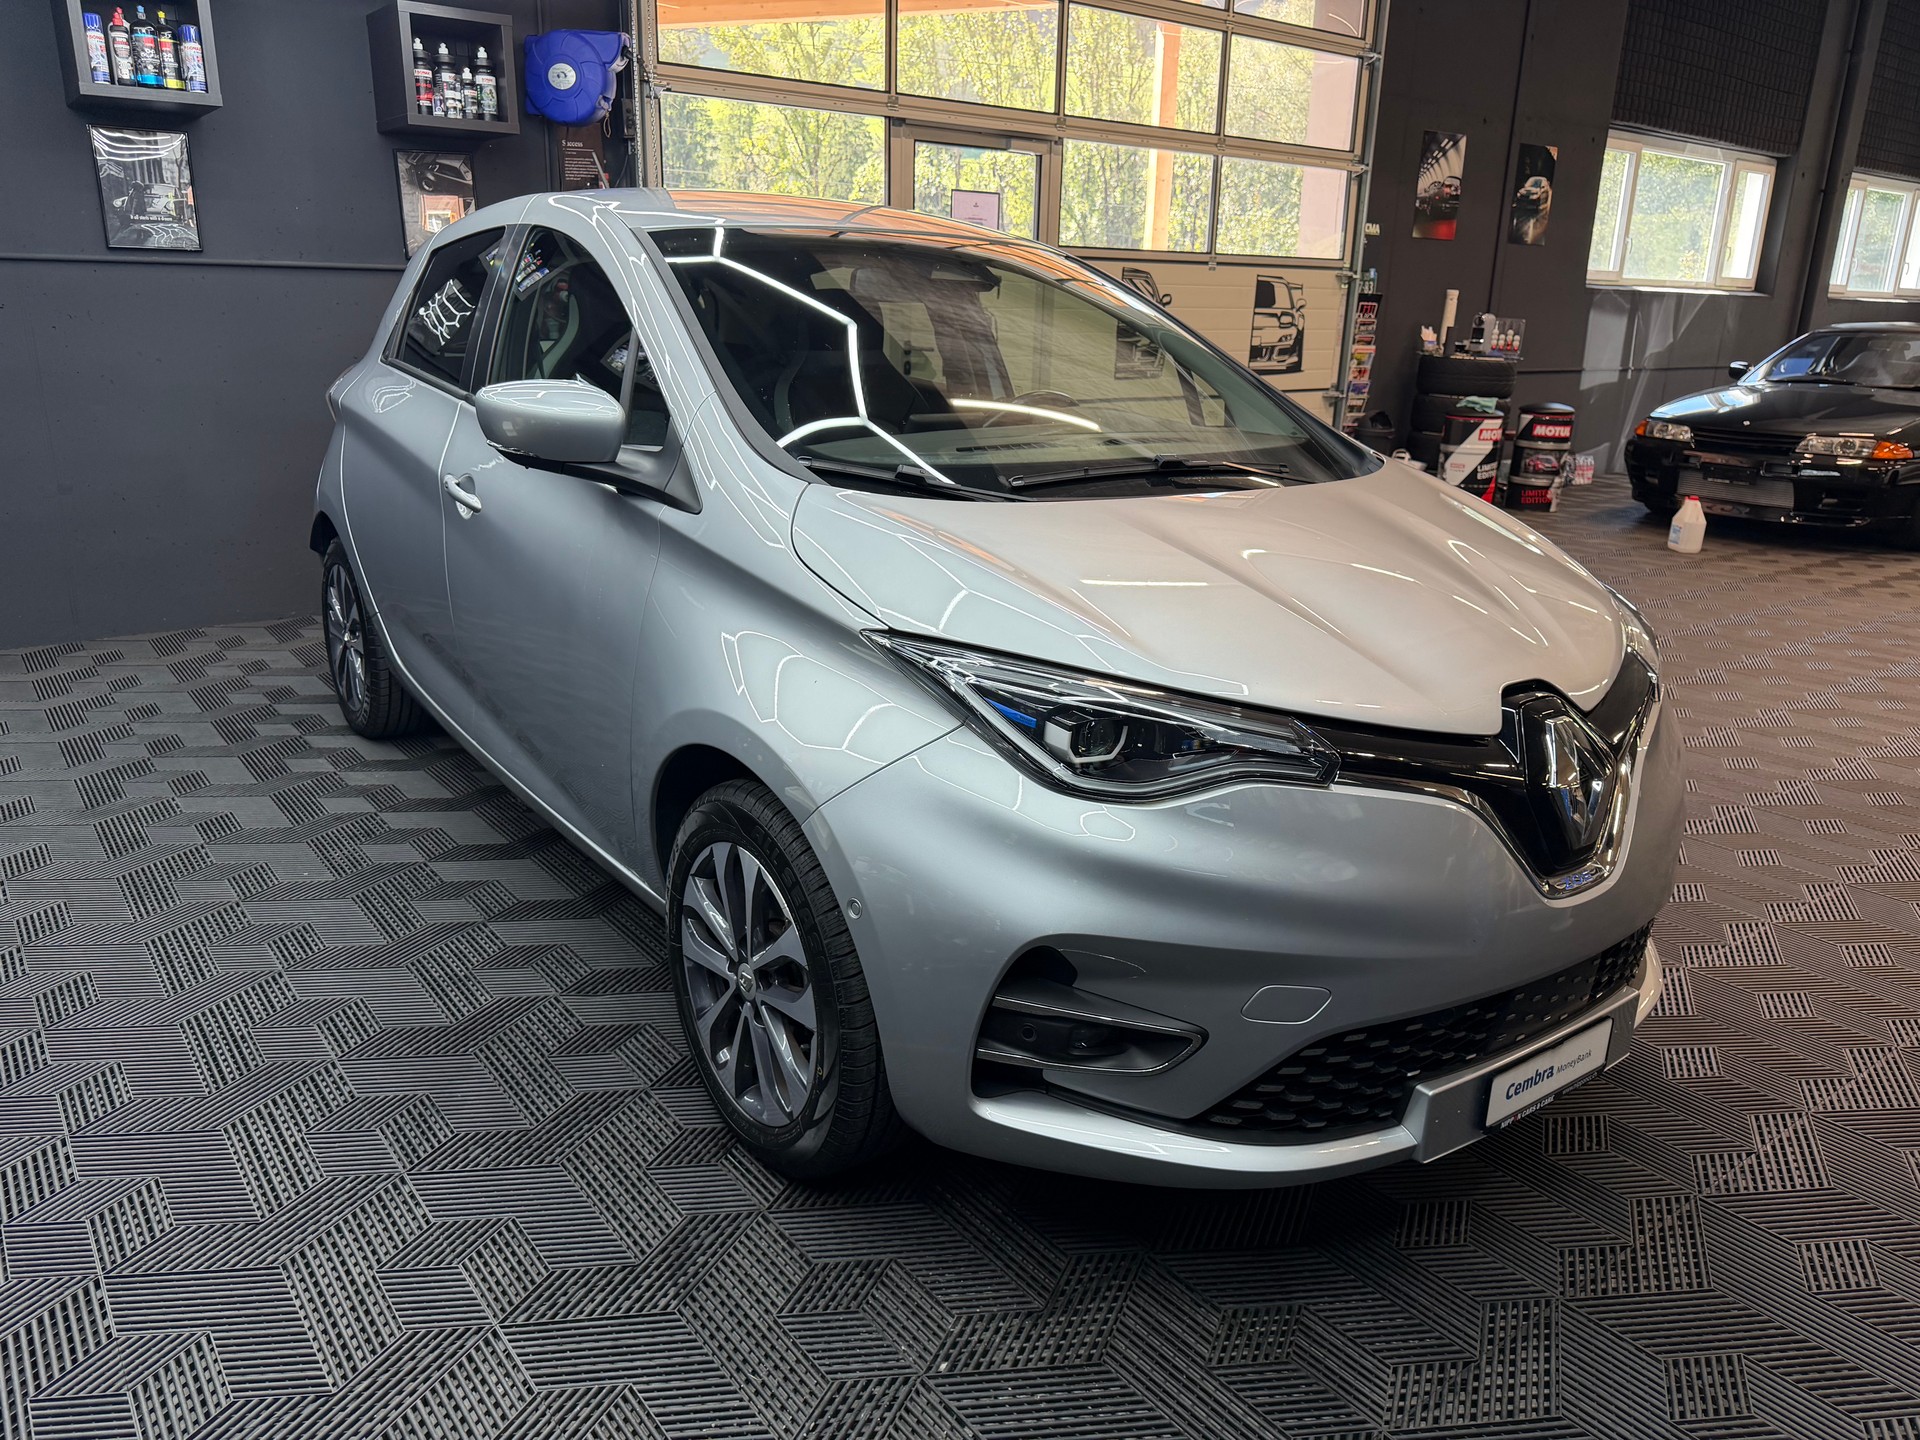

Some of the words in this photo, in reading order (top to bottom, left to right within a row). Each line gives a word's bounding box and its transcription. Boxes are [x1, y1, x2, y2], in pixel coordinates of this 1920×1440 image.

[1533, 424, 1571, 437] MOTUL
[1505, 1065, 1555, 1100] Cembra
[1556, 1049, 1592, 1074] MoneyBank
[1522, 1104, 1537, 1117] CARS
[1540, 1095, 1556, 1108] CARE
